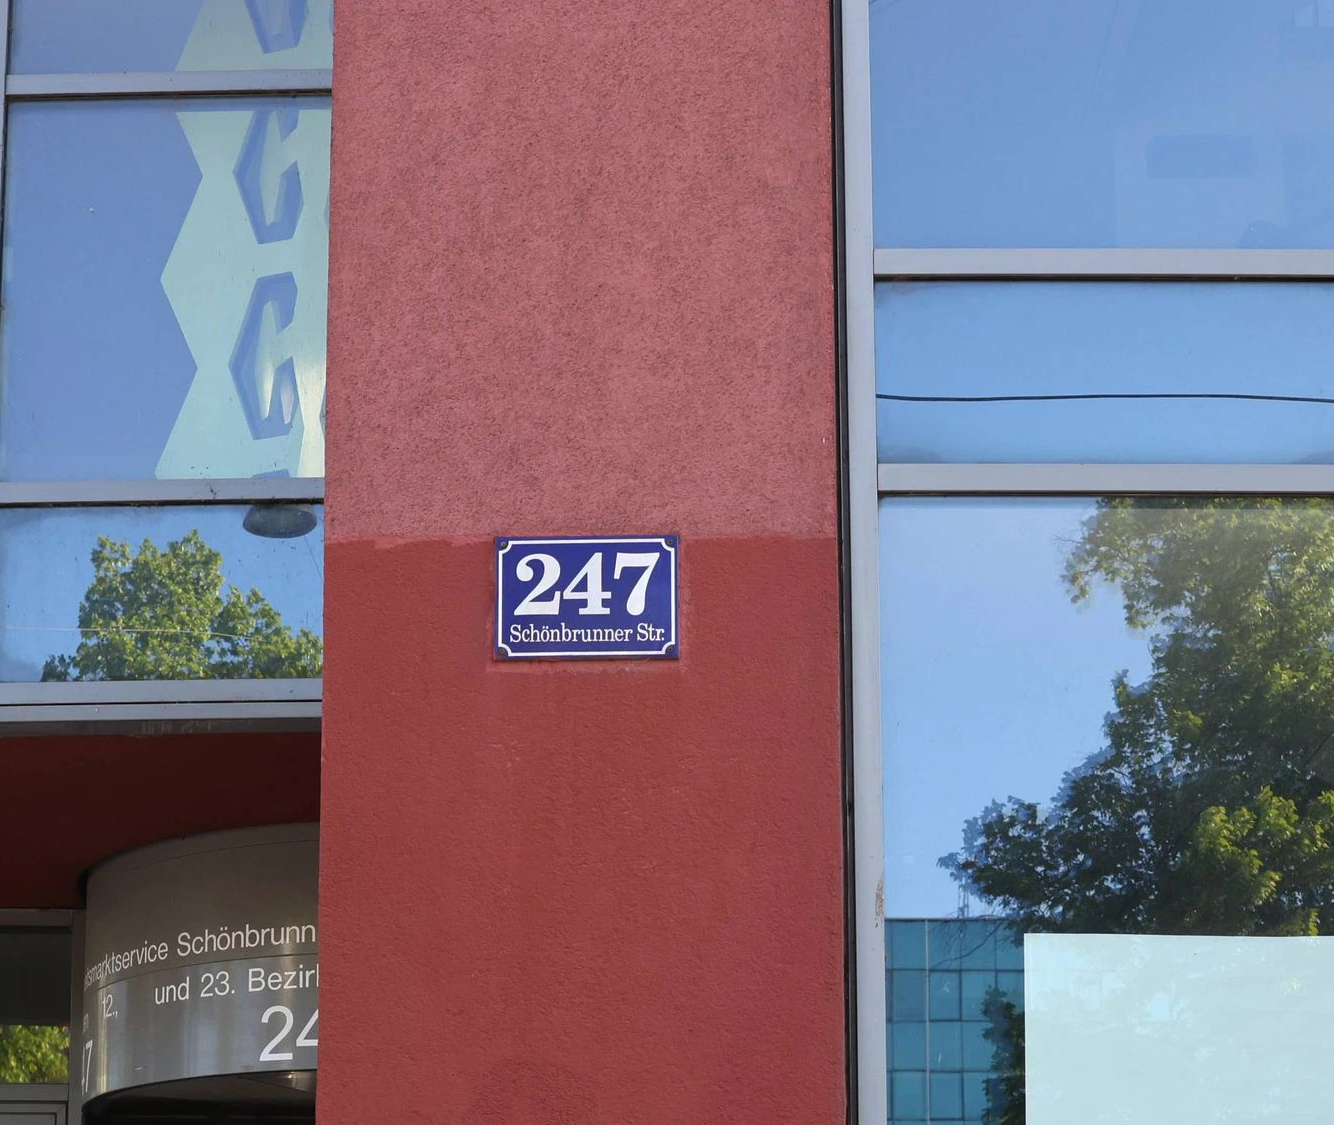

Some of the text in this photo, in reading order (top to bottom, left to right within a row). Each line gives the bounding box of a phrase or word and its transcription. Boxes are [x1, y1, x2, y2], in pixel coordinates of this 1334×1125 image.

[513, 552, 660, 616] 247
[509, 622, 665, 643] Schönbrunner Str.
[154, 976, 190, 1005] und
[200, 970, 235, 998] 23.
